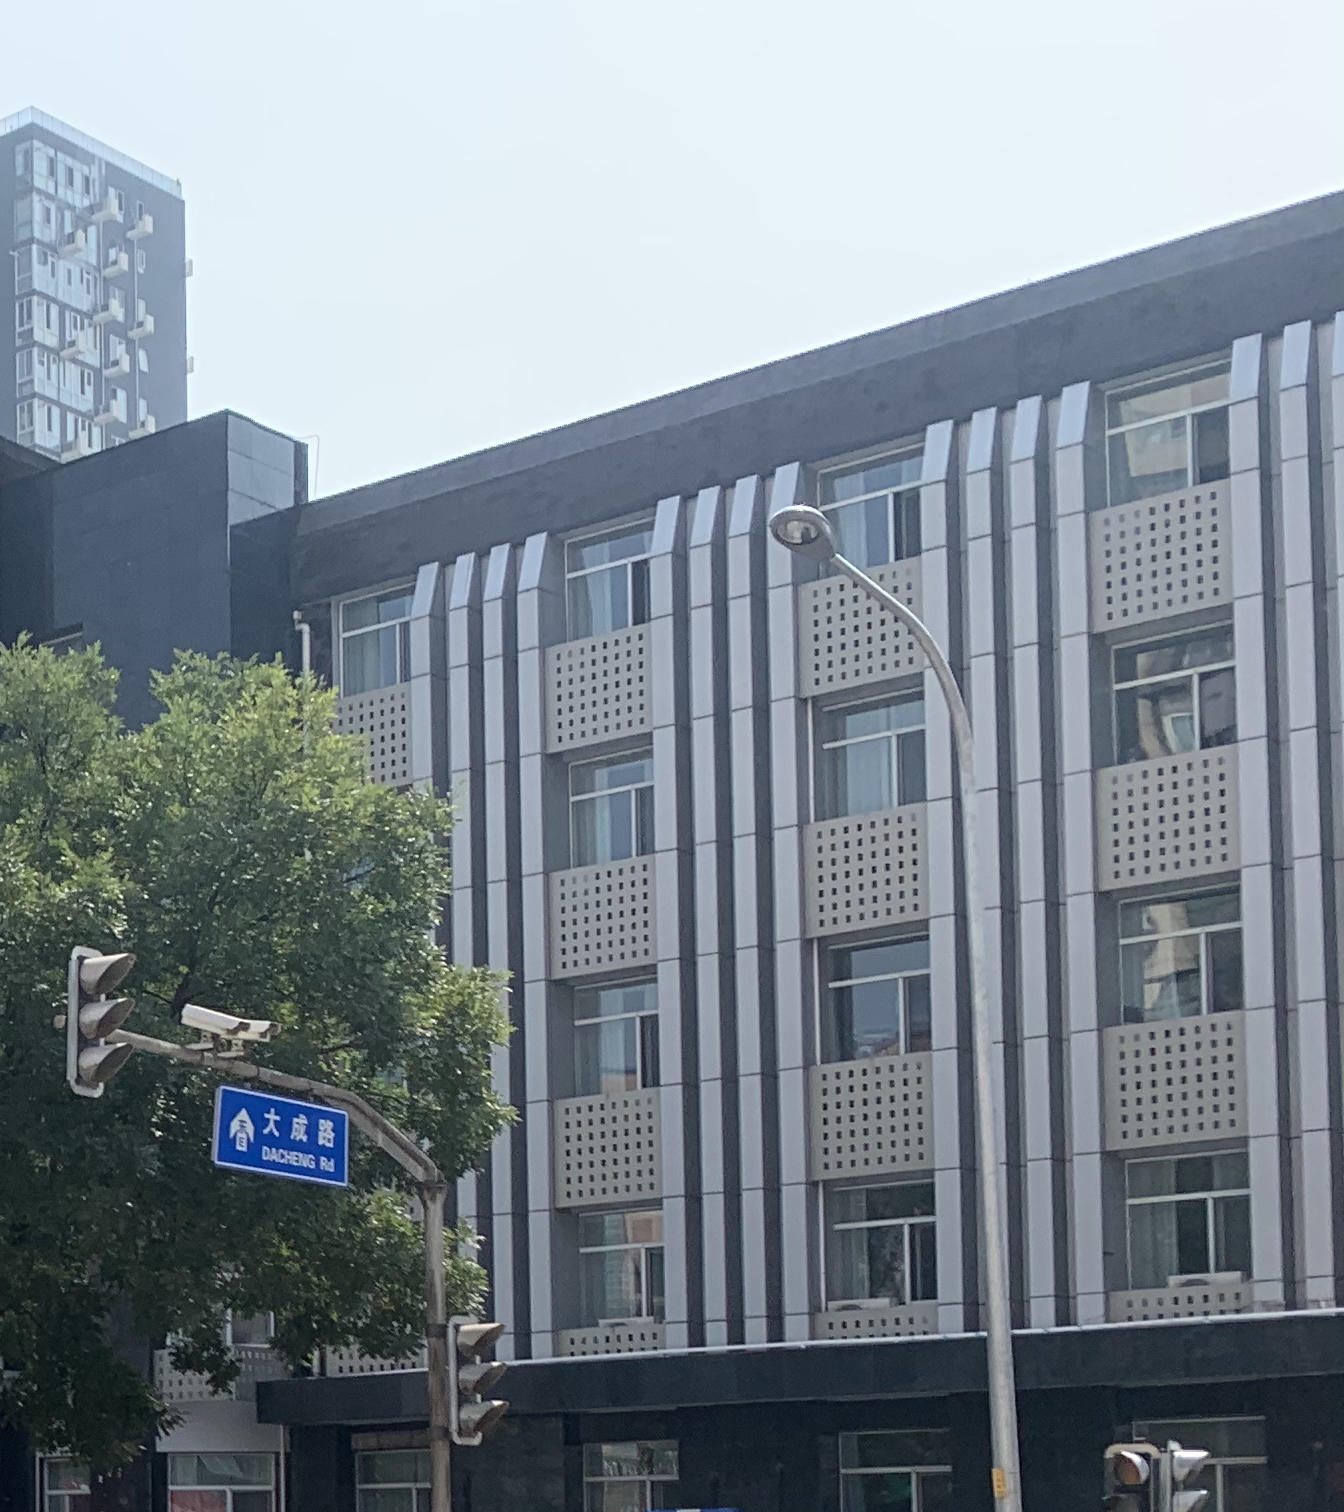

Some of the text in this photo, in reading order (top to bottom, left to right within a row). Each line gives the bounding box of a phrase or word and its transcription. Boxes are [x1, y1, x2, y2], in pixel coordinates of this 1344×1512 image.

[263, 1107, 335, 1148] 大成路
[261, 1145, 336, 1173] DACHENG Rd
